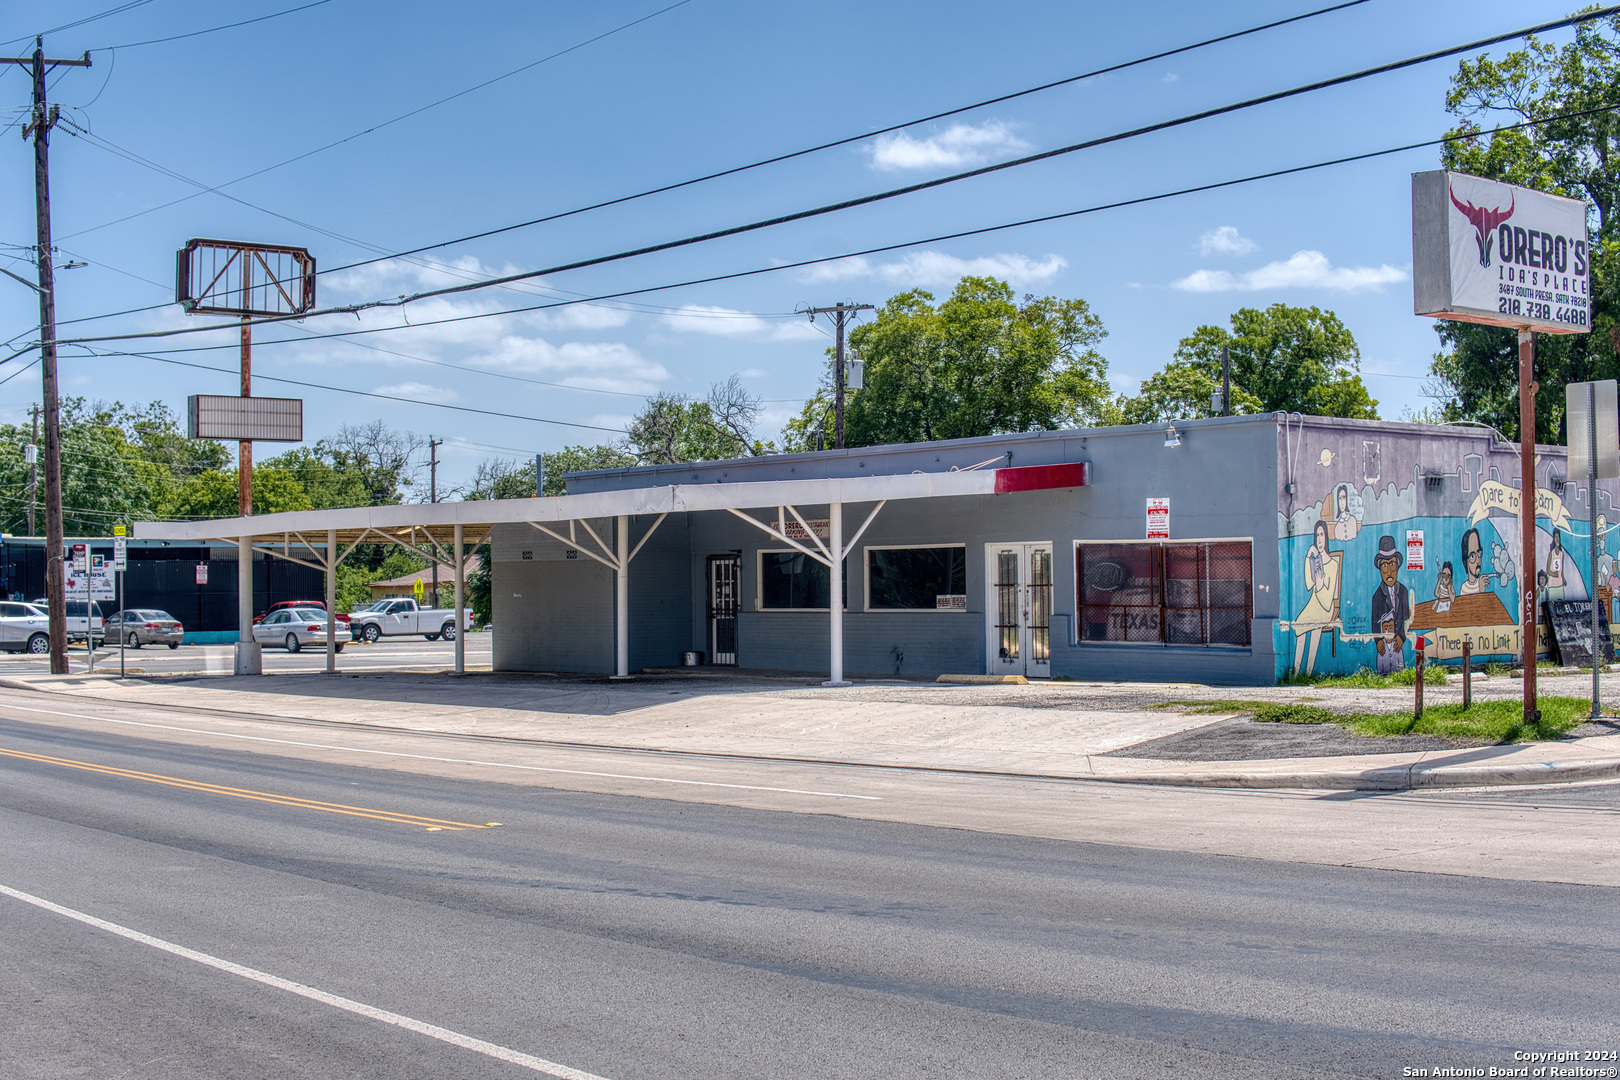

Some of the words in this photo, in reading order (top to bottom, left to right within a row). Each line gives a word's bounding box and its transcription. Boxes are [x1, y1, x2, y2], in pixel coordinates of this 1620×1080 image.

[1499, 265, 1538, 286] IDA'S
[1544, 273, 1587, 294] PLACE
[1515, 286, 1535, 299] SOUTH
[1555, 293, 1570, 305] SATX
[1481, 488, 1504, 506] Dare
[1508, 492, 1519, 508] to
[1554, 561, 1559, 570] 5
[1112, 613, 1159, 630] TEXAS
[1439, 635, 1461, 651] There
[1478, 635, 1490, 650] no
[1492, 629, 1510, 651] Limit
